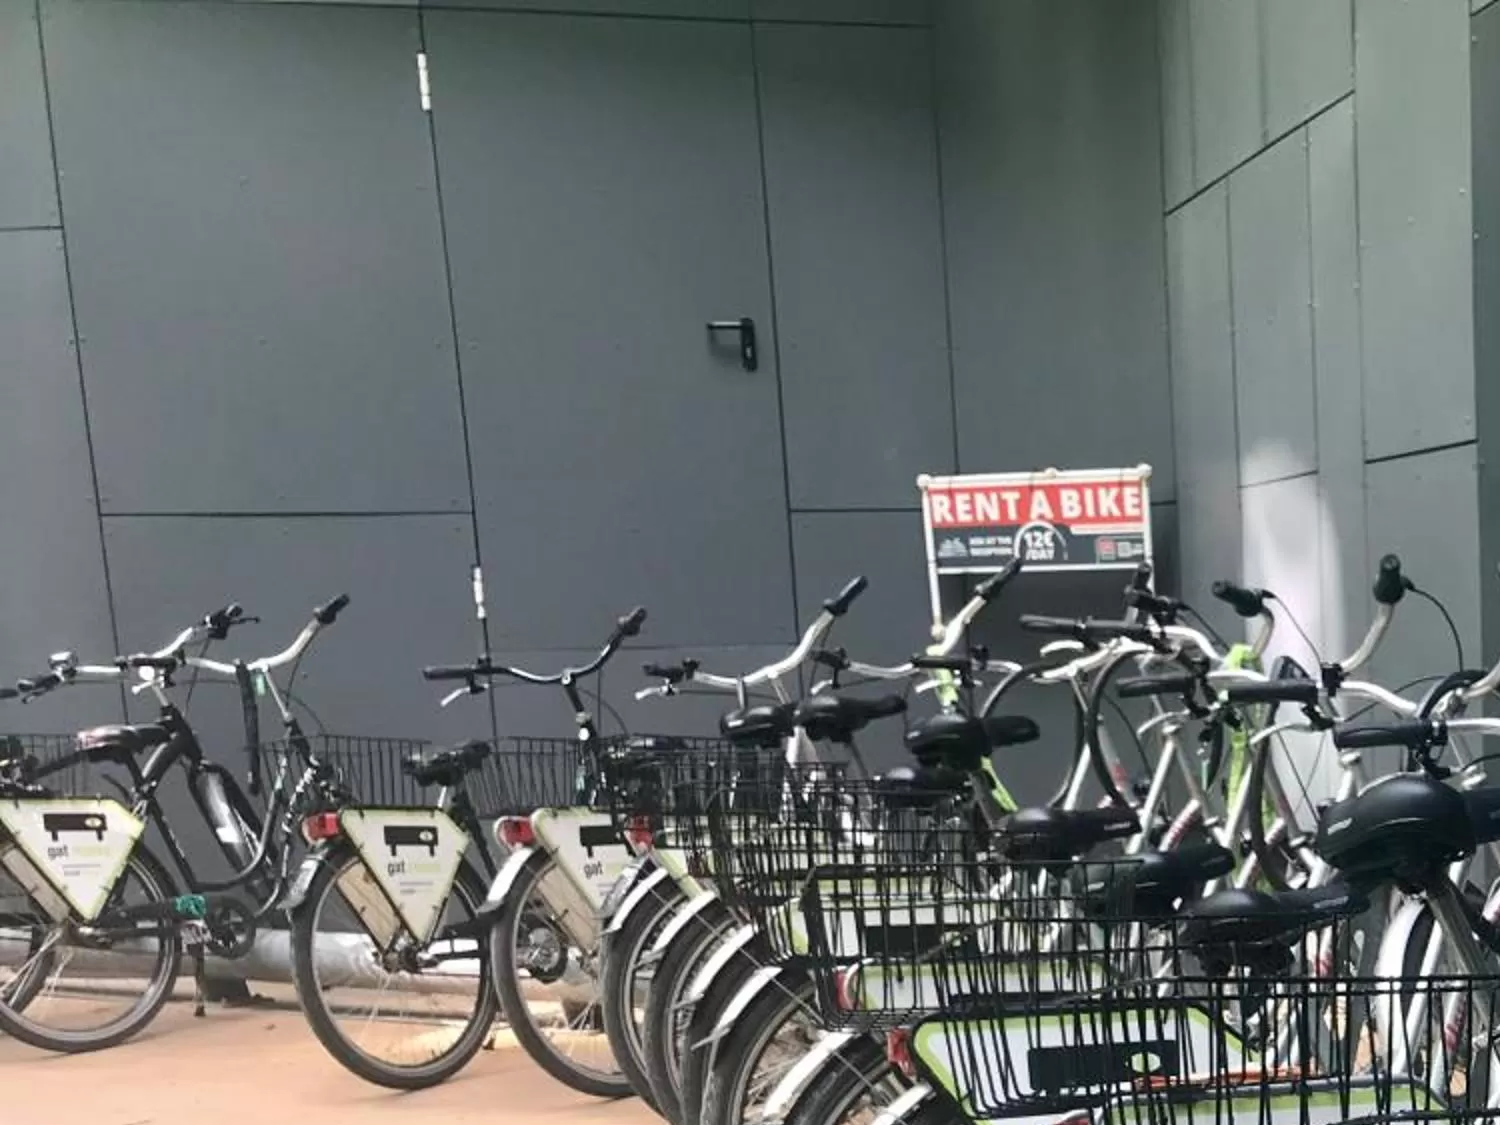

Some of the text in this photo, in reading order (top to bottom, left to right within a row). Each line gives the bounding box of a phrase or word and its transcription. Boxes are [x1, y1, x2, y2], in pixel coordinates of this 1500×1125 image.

[932, 484, 1142, 524] RENT A BIKE
